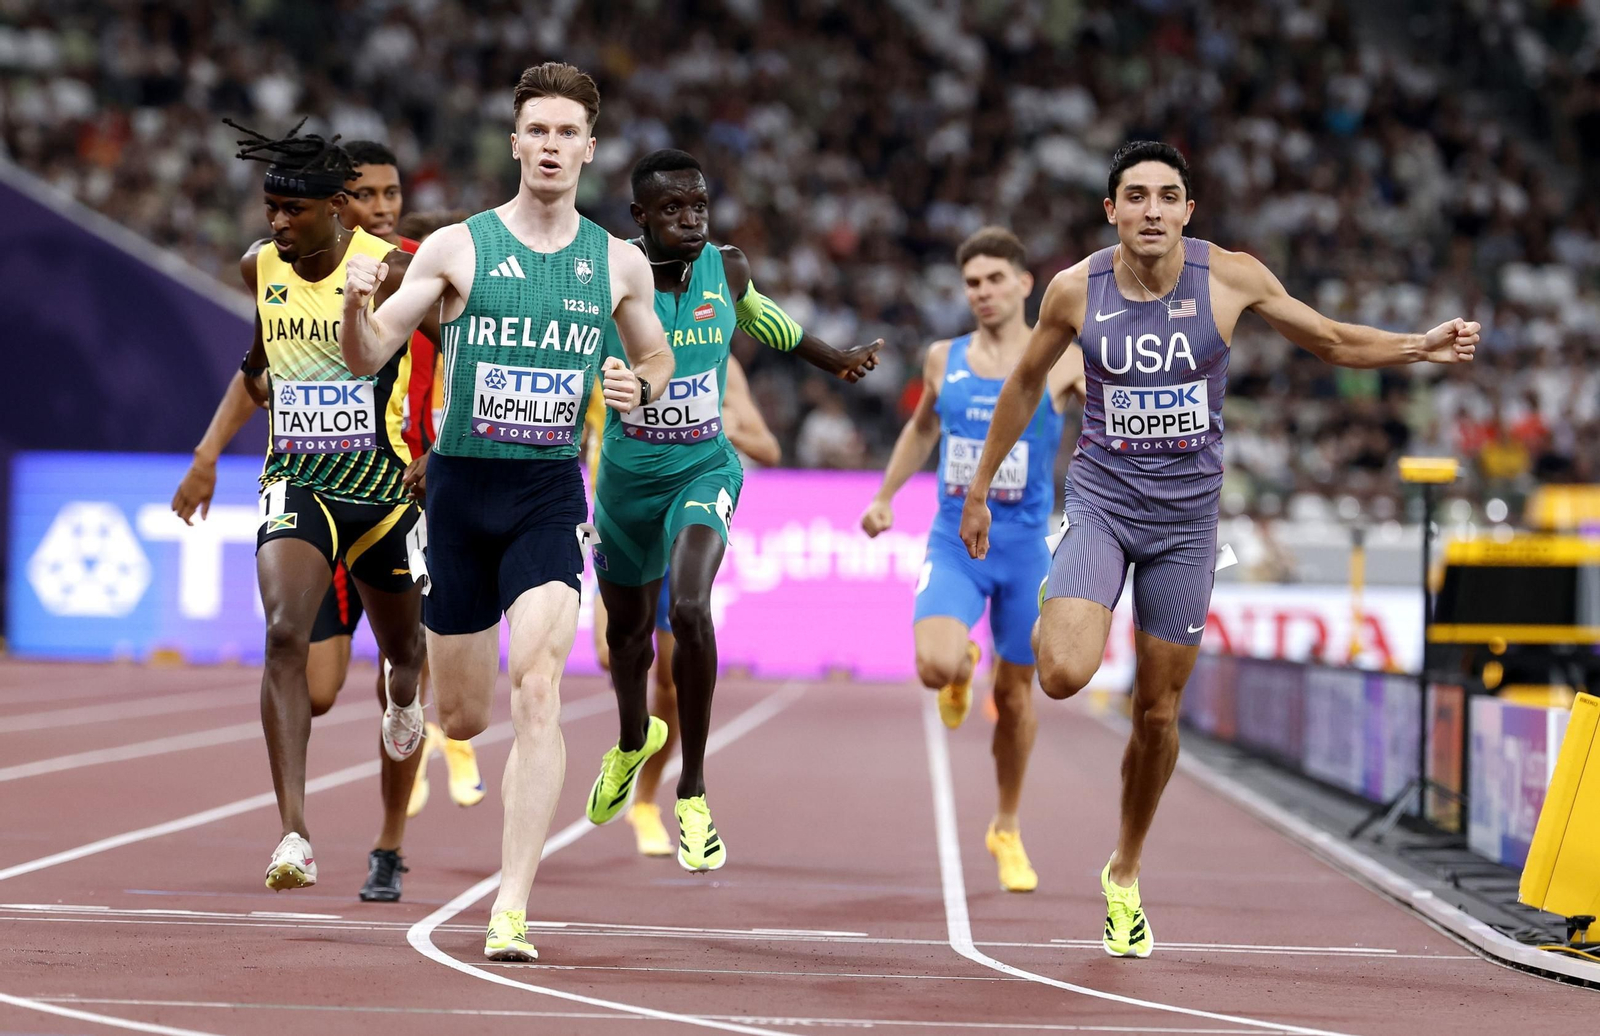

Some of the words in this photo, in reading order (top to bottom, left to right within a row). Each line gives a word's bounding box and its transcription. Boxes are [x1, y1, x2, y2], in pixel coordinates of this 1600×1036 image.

[563, 298, 600, 315] 123.ie
[266, 318, 340, 342] JAMAIC
[468, 315, 601, 355] IRELAND
[665, 327, 723, 347] TRALIA
[1101, 332, 1197, 375] USA
[508, 370, 576, 395] TDK
[658, 373, 711, 401] DK
[296, 385, 366, 406] TDK
[1130, 385, 1200, 410] TDK
[278, 409, 369, 432] TAYLOR
[478, 394, 576, 424] McPHILLIPS
[643, 405, 700, 426] BOL
[1111, 411, 1205, 436] HOPPEL
[262, 491, 271, 517] 1
